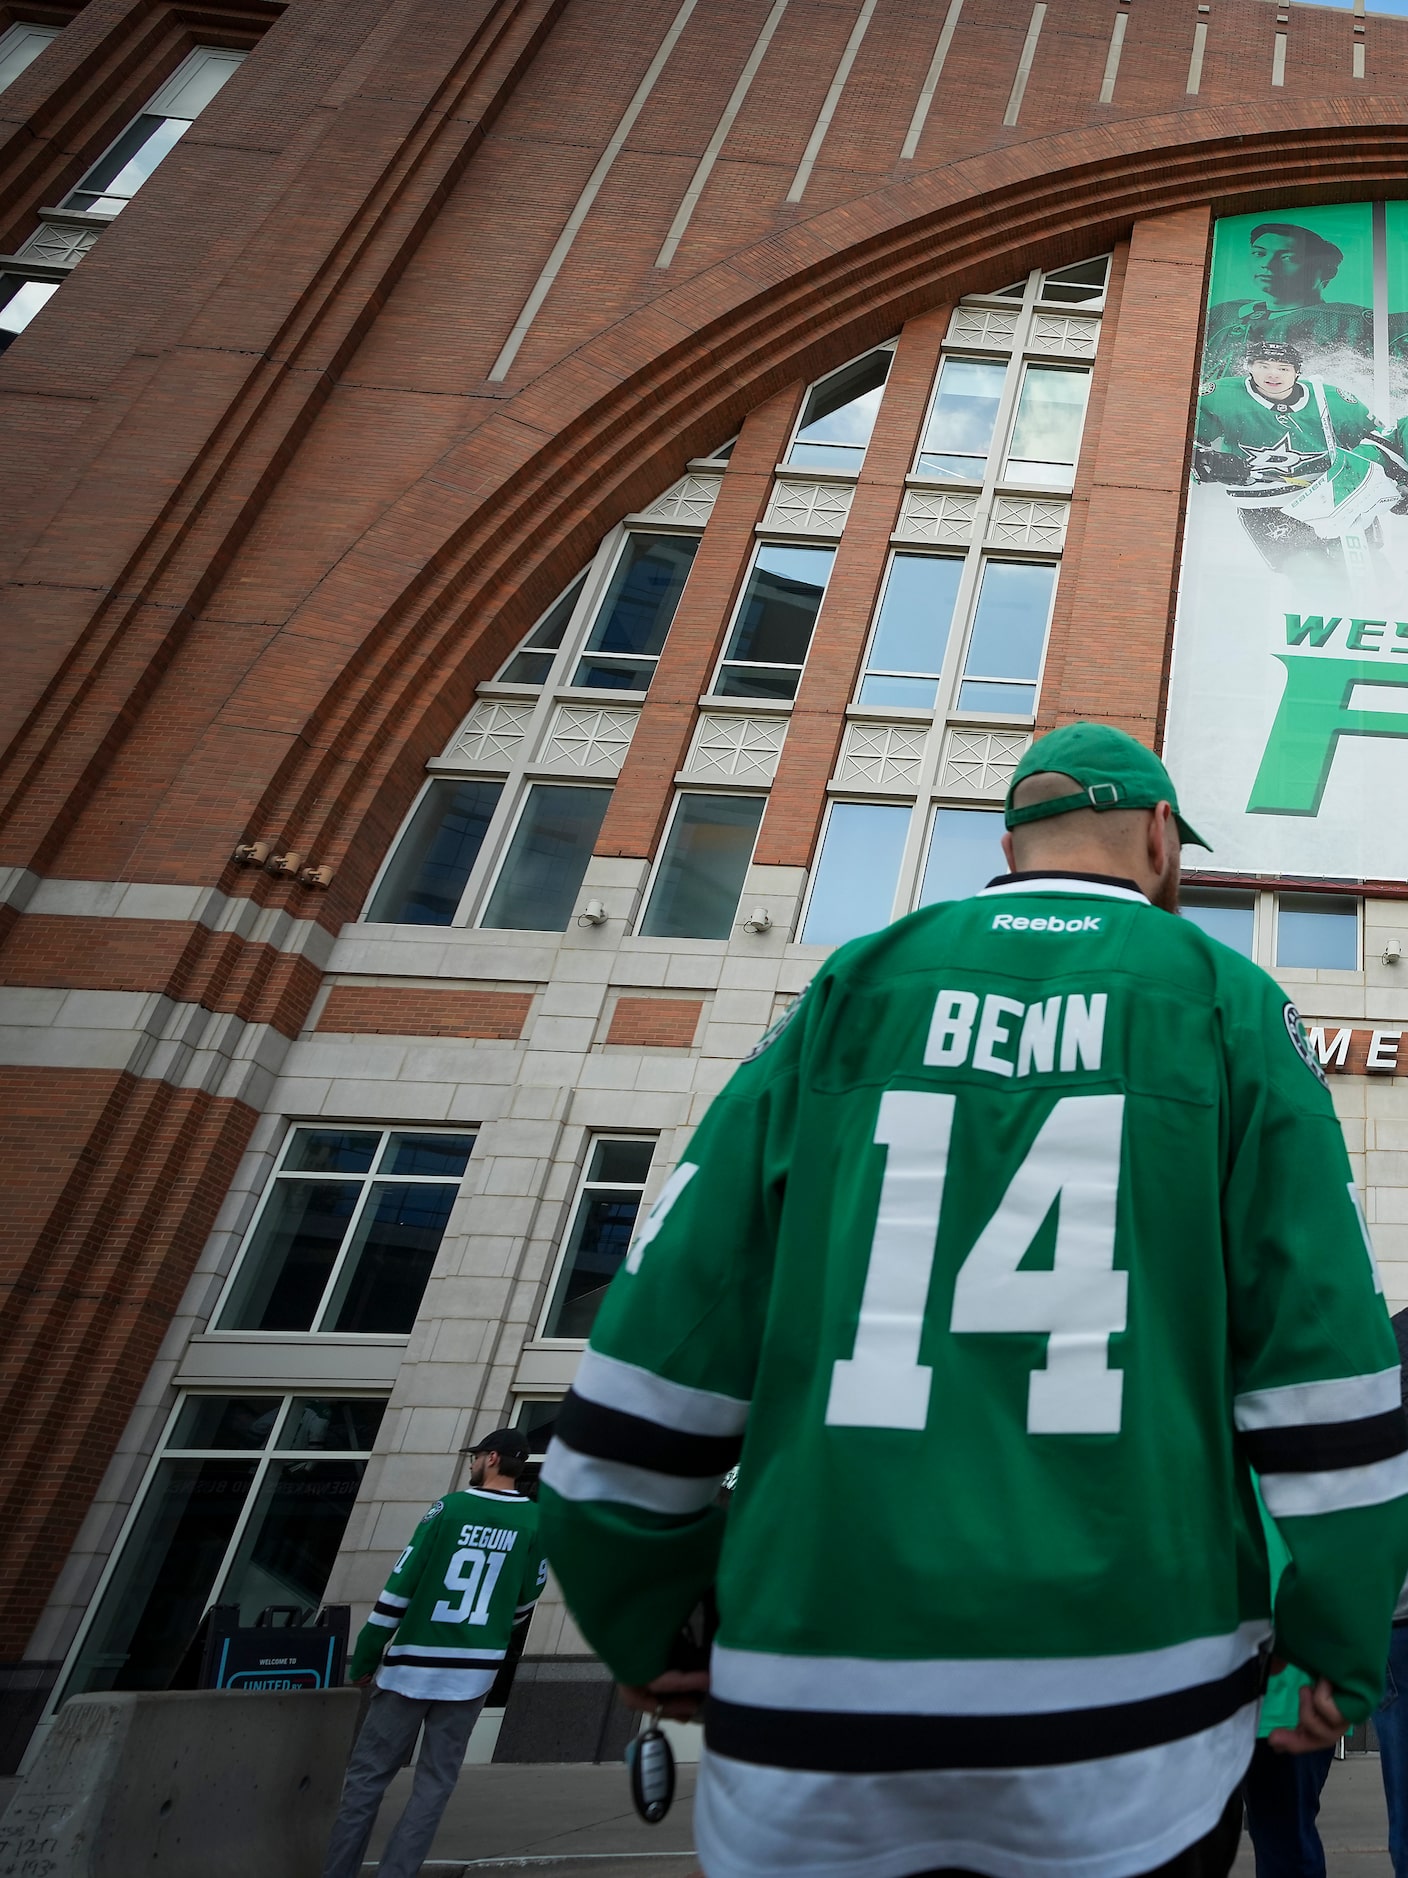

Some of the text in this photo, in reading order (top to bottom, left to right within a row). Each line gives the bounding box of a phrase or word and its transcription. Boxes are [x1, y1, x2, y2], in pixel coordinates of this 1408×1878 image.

[992, 914, 1102, 933] Reebok
[922, 989, 1107, 1078] BENN
[824, 1090, 1129, 1435] 14
[457, 1524, 518, 1551] SEGUIN
[430, 1547, 507, 1626] 91
[259, 1657, 297, 1666] WELCOME TO
[243, 1679, 291, 1690] UNITED
